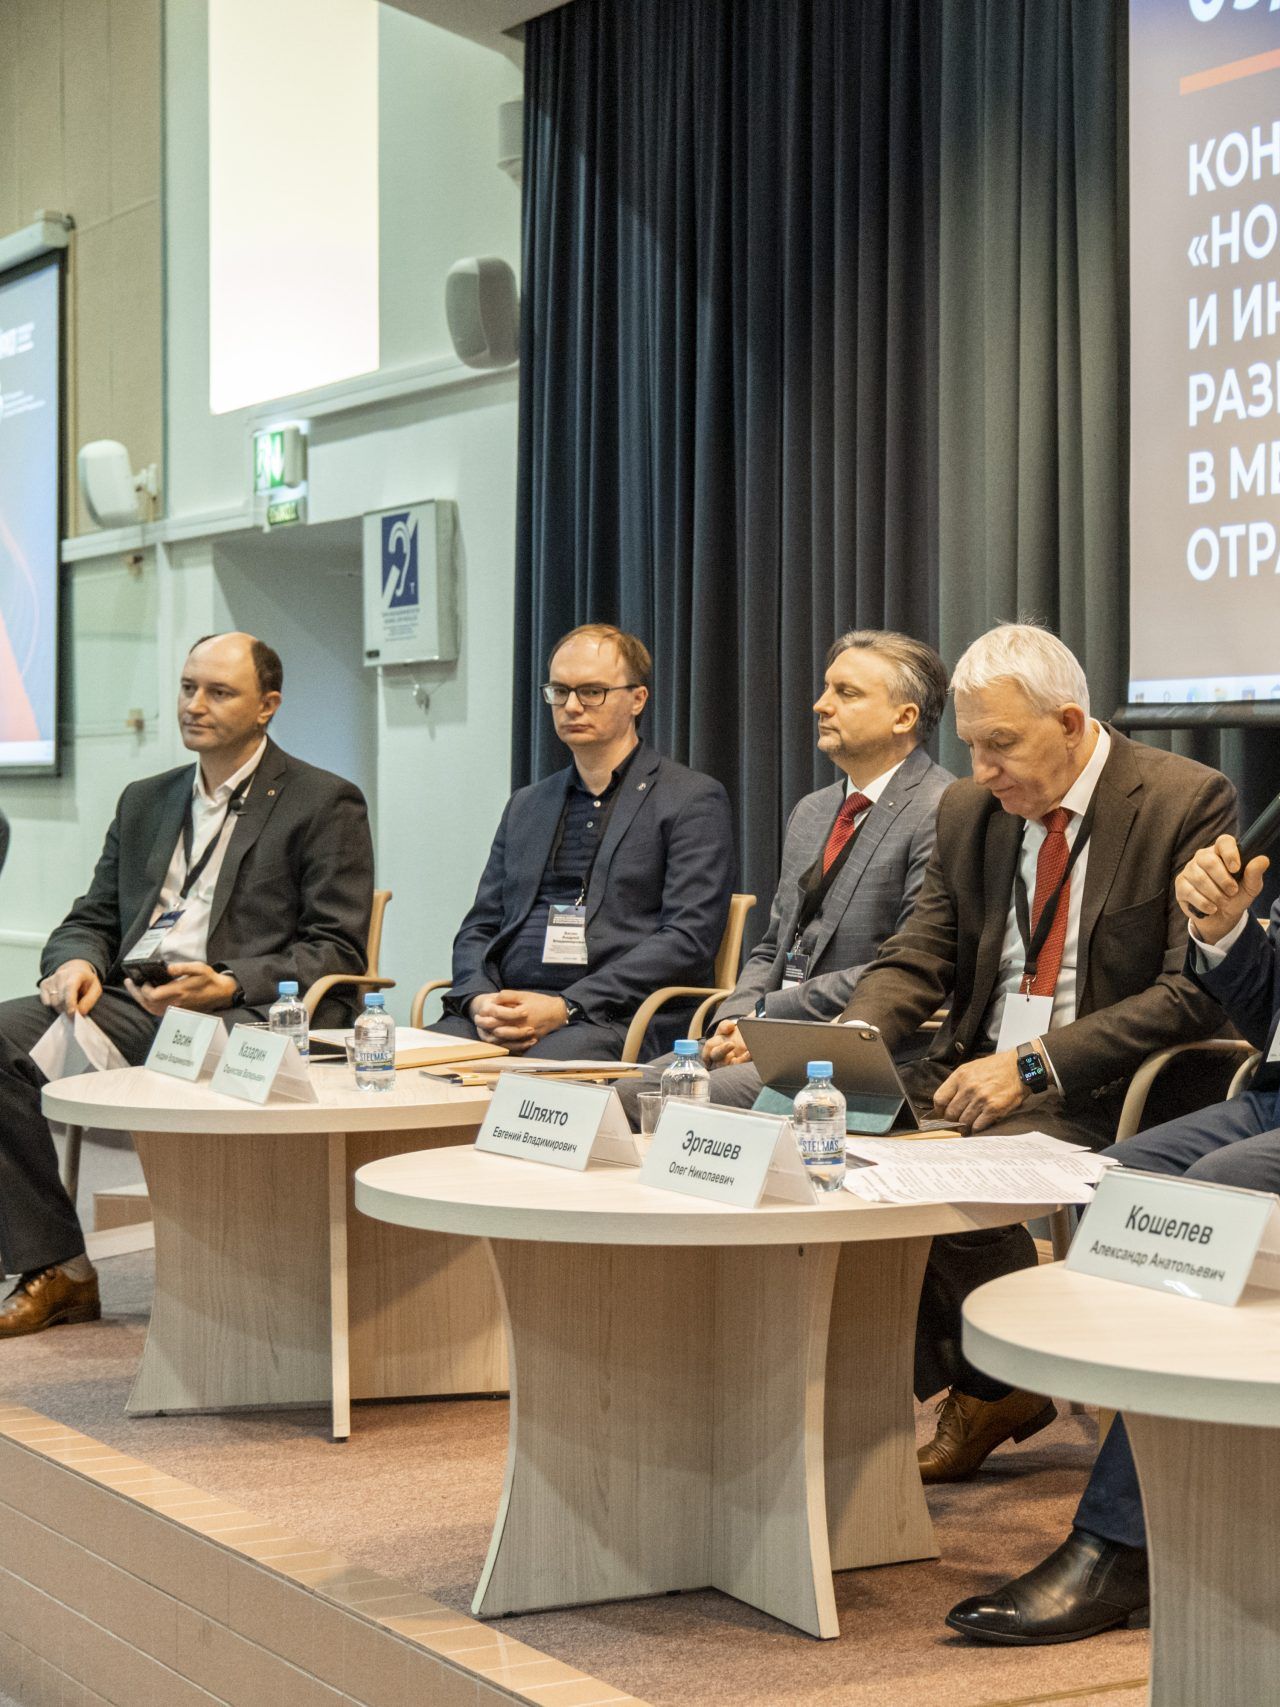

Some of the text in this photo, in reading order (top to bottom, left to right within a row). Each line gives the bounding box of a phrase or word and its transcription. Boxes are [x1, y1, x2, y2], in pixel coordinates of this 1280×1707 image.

[1189, 294, 1218, 349] И
[1188, 450, 1216, 505] В
[518, 1099, 569, 1126] Шляхто
[492, 1126, 578, 1153] Евгений Владимирович
[682, 1129, 742, 1160] Эргашев
[802, 1140, 839, 1152] STELMAS
[668, 1161, 735, 1186] Олег Николаевич
[1125, 1204, 1214, 1245] Кошелев
[1090, 1240, 1226, 1282] Александр Анатольевич
